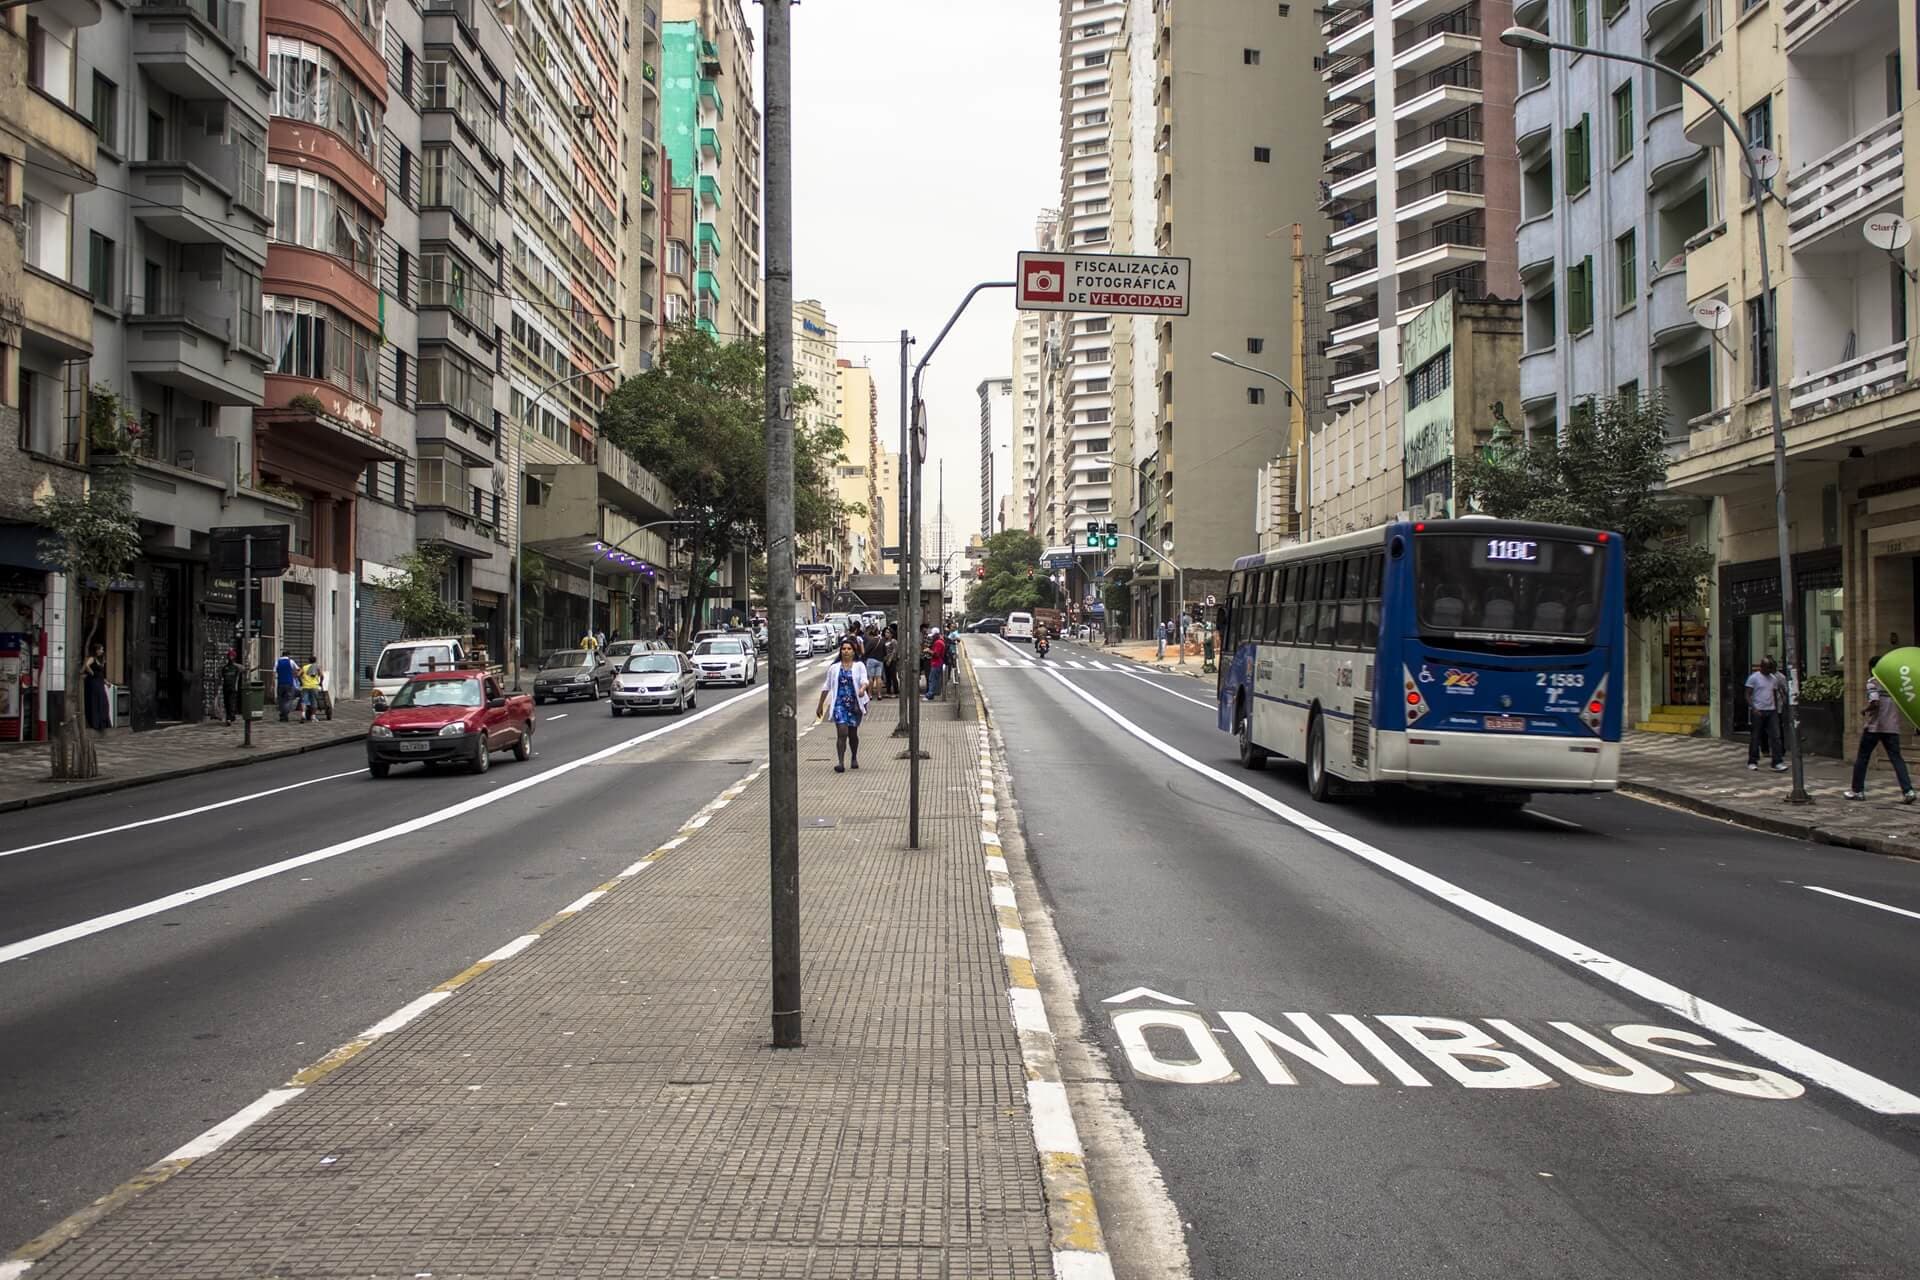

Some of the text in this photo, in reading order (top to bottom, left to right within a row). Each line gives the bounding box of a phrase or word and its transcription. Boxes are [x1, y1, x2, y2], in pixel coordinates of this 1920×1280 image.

[1075, 261, 1179, 277] FISCALIZAÇÃO
[1076, 275, 1177, 291] FOTOGRÁFICA
[1068, 292, 1182, 308] DE VELOCIDADE
[1487, 539, 1537, 560] 118C
[1536, 673, 1585, 687] 2 1583
[1898, 664, 1917, 703] vivo
[1102, 986, 1807, 1100] ÔNIBUS
